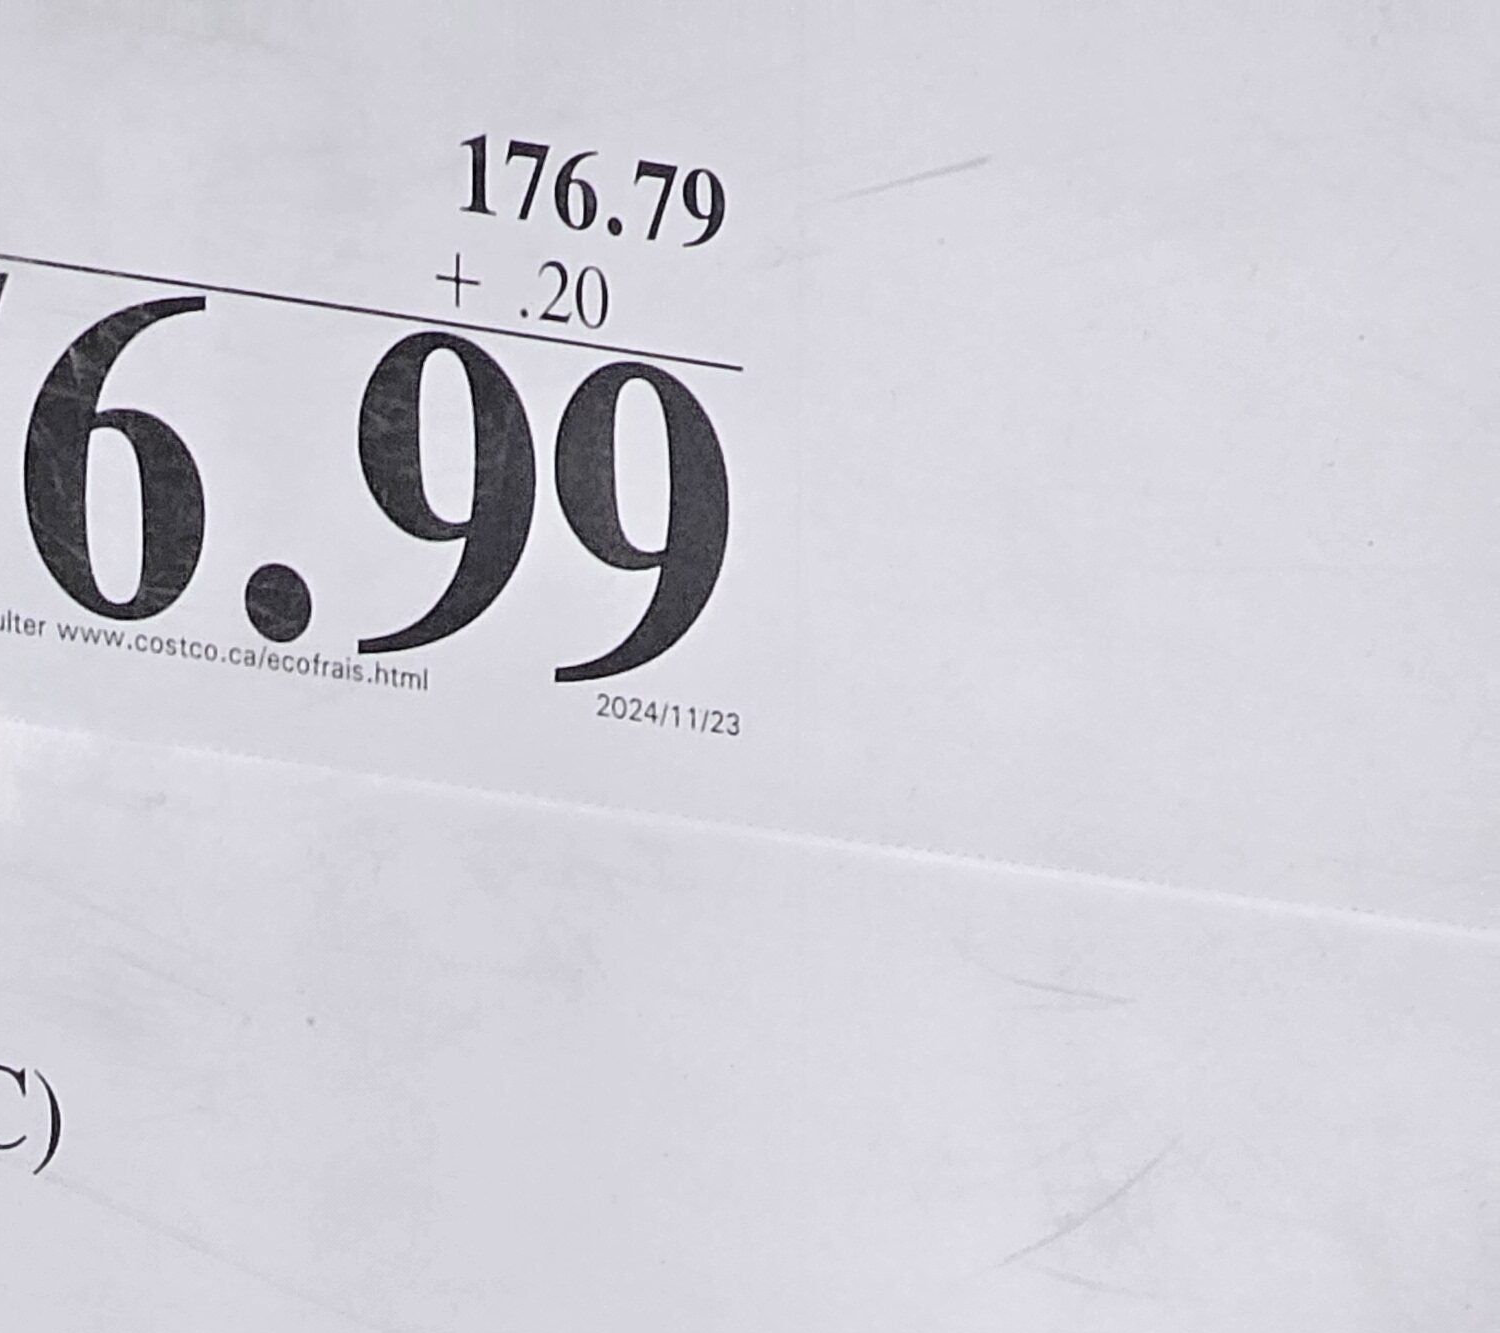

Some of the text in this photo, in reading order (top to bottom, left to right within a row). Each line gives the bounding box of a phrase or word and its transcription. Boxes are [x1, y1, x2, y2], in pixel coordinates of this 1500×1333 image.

[460, 133, 727, 249] 176.79
[519, 259, 610, 330] .20
[56, 622, 429, 692] www.costco.ca/ecofrais.html
[595, 692, 741, 737] 2024/11/23
